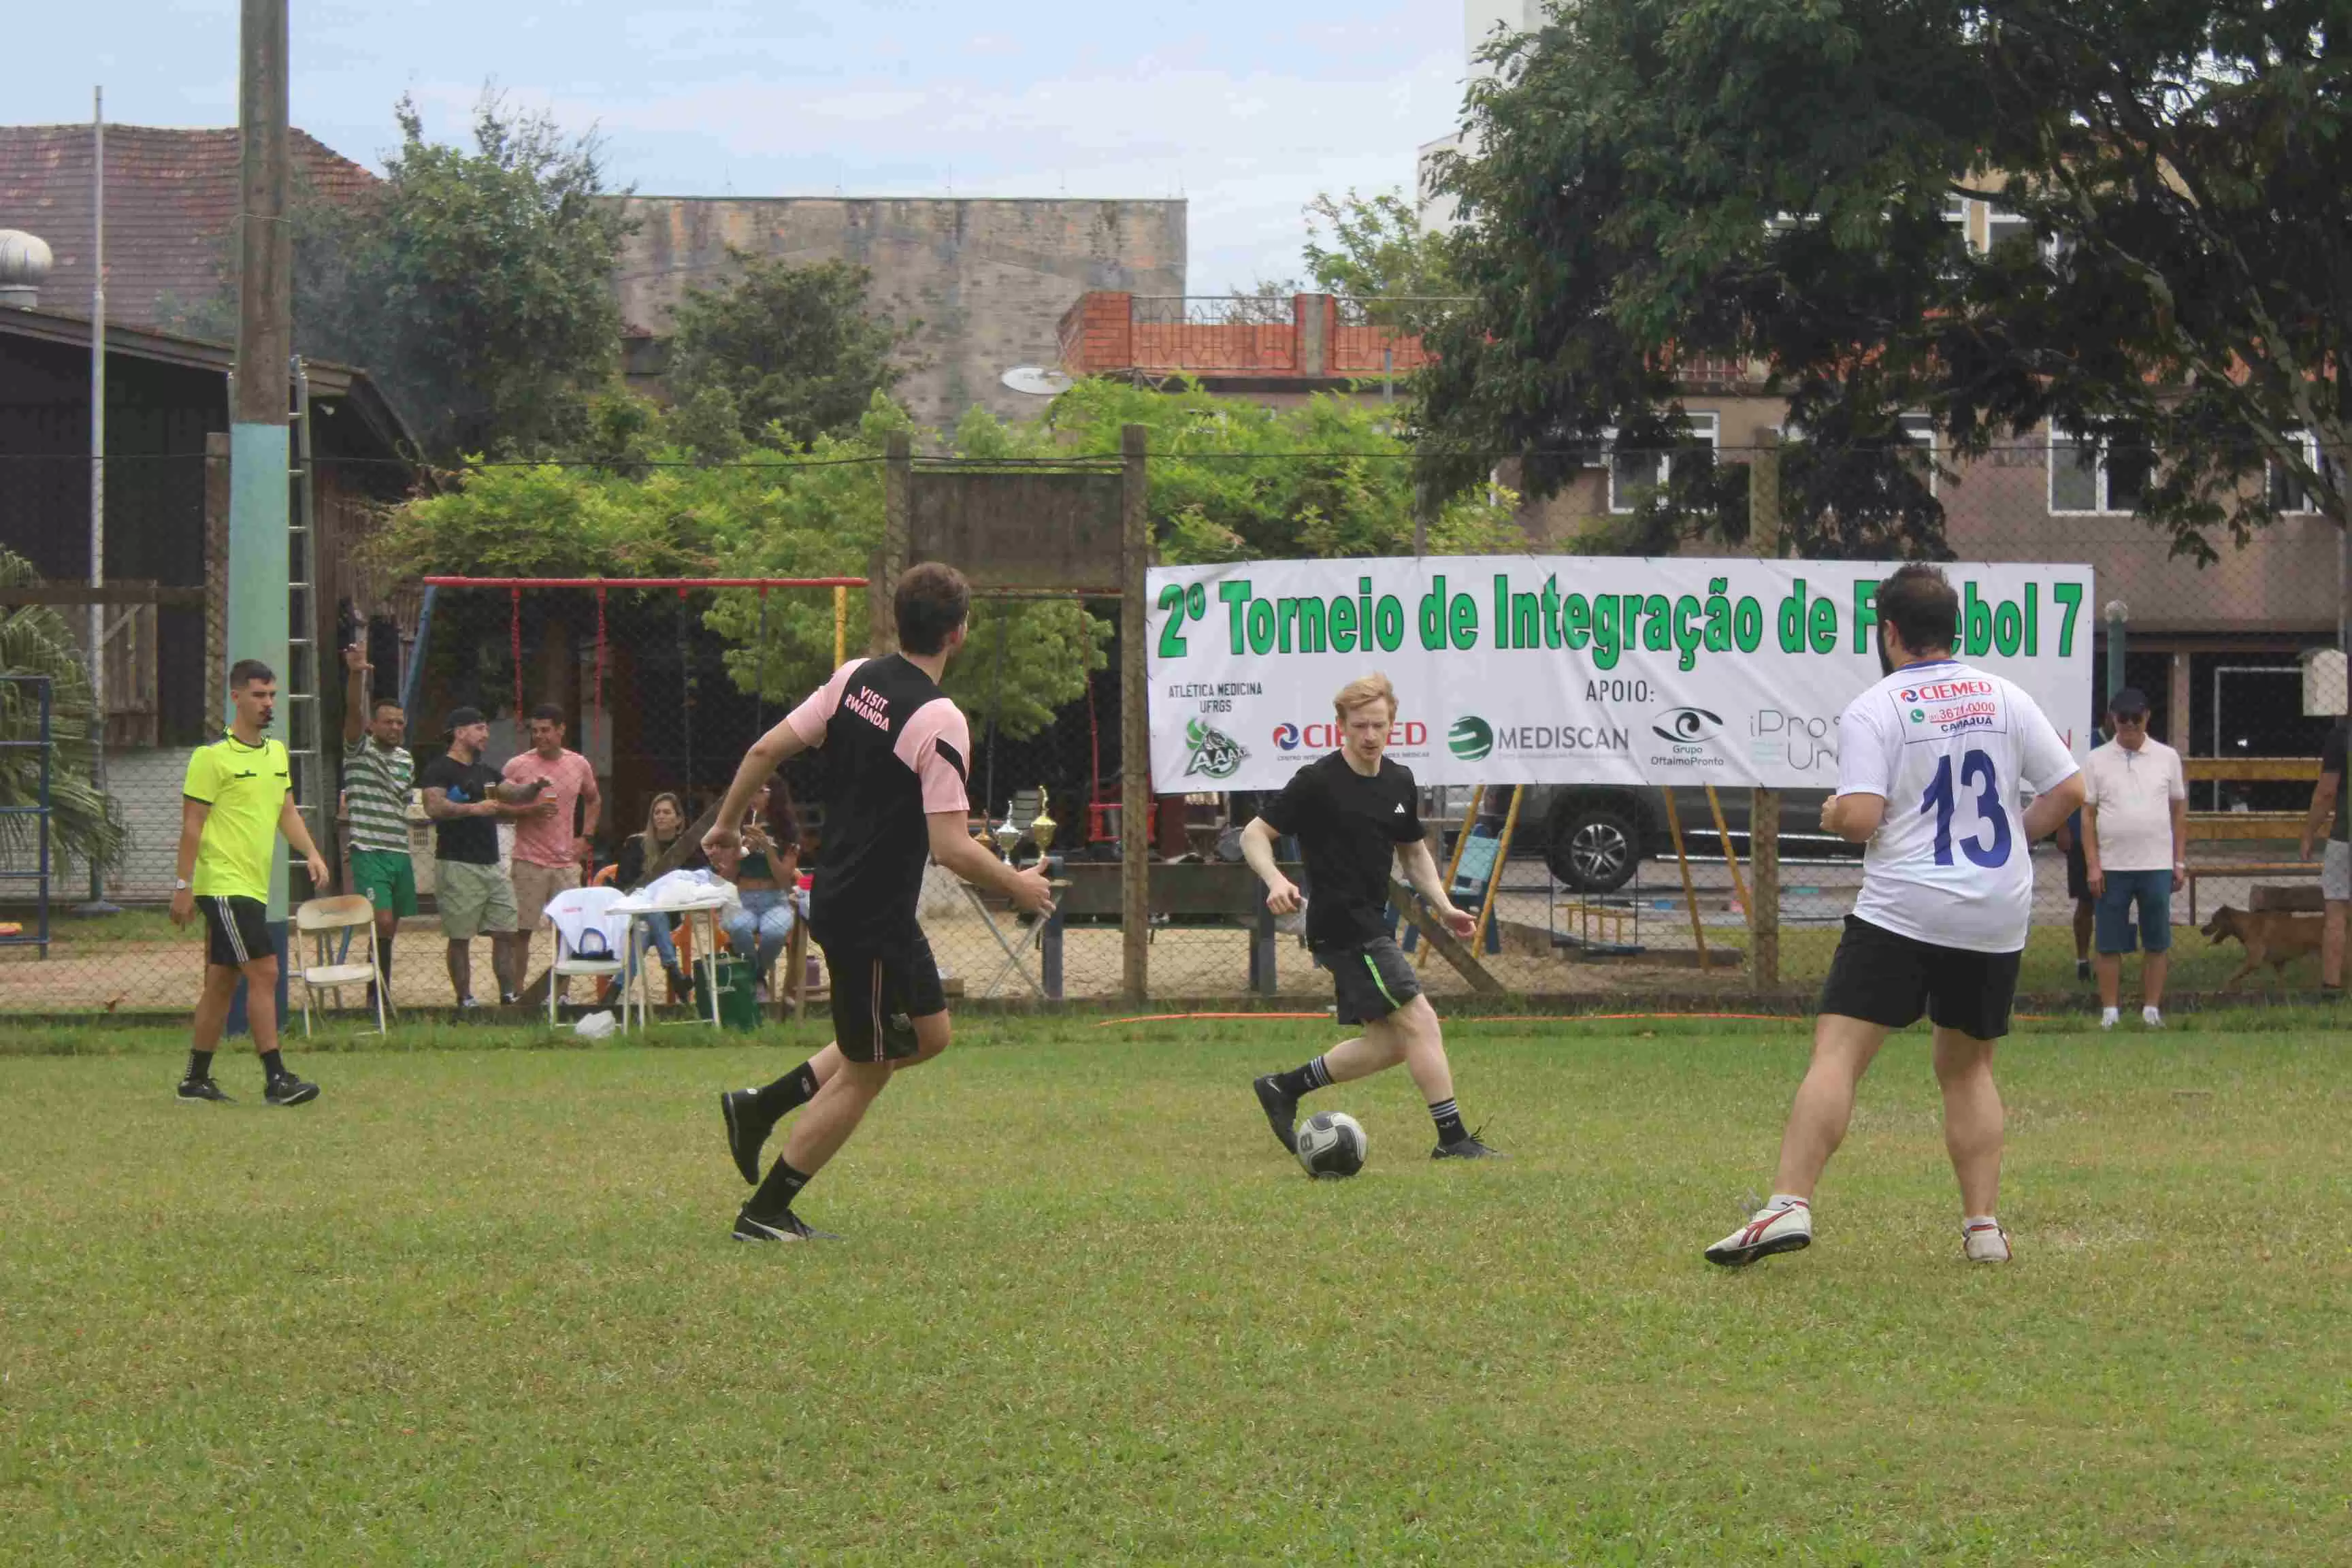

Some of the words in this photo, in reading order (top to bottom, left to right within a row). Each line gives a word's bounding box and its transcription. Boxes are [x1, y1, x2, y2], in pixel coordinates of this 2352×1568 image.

[1219, 575, 1404, 655] Torneio
[1419, 574, 1478, 651] de
[1494, 573, 1763, 671] Integração
[1778, 578, 1838, 655] de
[2054, 583, 2082, 657] 7
[860, 686, 889, 713] VISIT
[1169, 683, 1215, 698] ATLÉTICA
[1217, 682, 1263, 696] MEDICINA
[1586, 680, 1655, 702] APOIO:
[1919, 681, 1993, 700] CIEMED
[844, 693, 890, 732] RWANDA
[1199, 700, 1232, 713] UFRGS
[1498, 726, 1629, 749] MEDISCAN
[1650, 755, 1724, 766] OftalmoPronto
[1672, 745, 1703, 754] Grupo
[1921, 749, 2012, 868] 13
